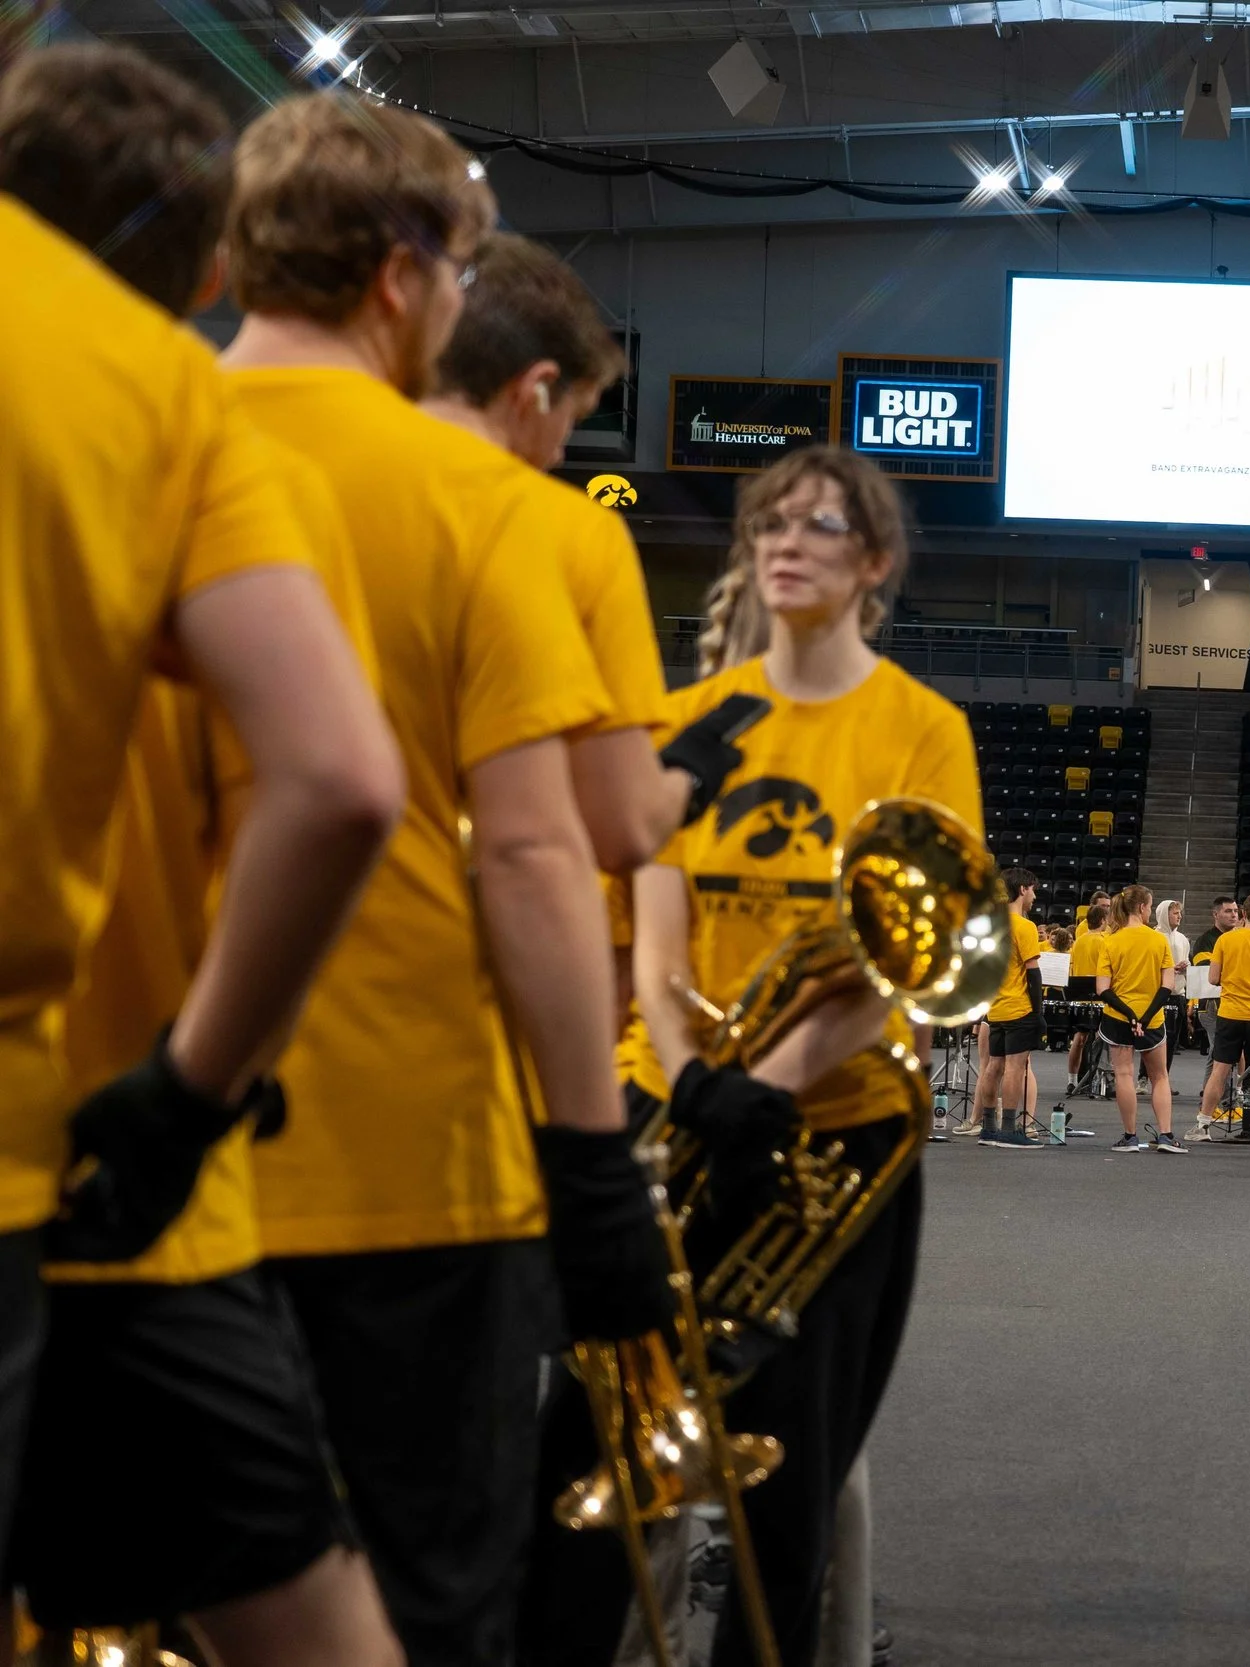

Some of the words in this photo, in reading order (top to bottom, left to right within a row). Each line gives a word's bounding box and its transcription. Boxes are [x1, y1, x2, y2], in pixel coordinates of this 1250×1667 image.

[878, 389, 958, 419] BUD
[715, 422, 773, 434] UNIVERSITY
[784, 424, 812, 436] IOWA
[861, 416, 972, 448] LIGHT
[715, 432, 757, 444] HEALTH
[758, 434, 787, 445] CARE
[1151, 464, 1178, 473] BAND
